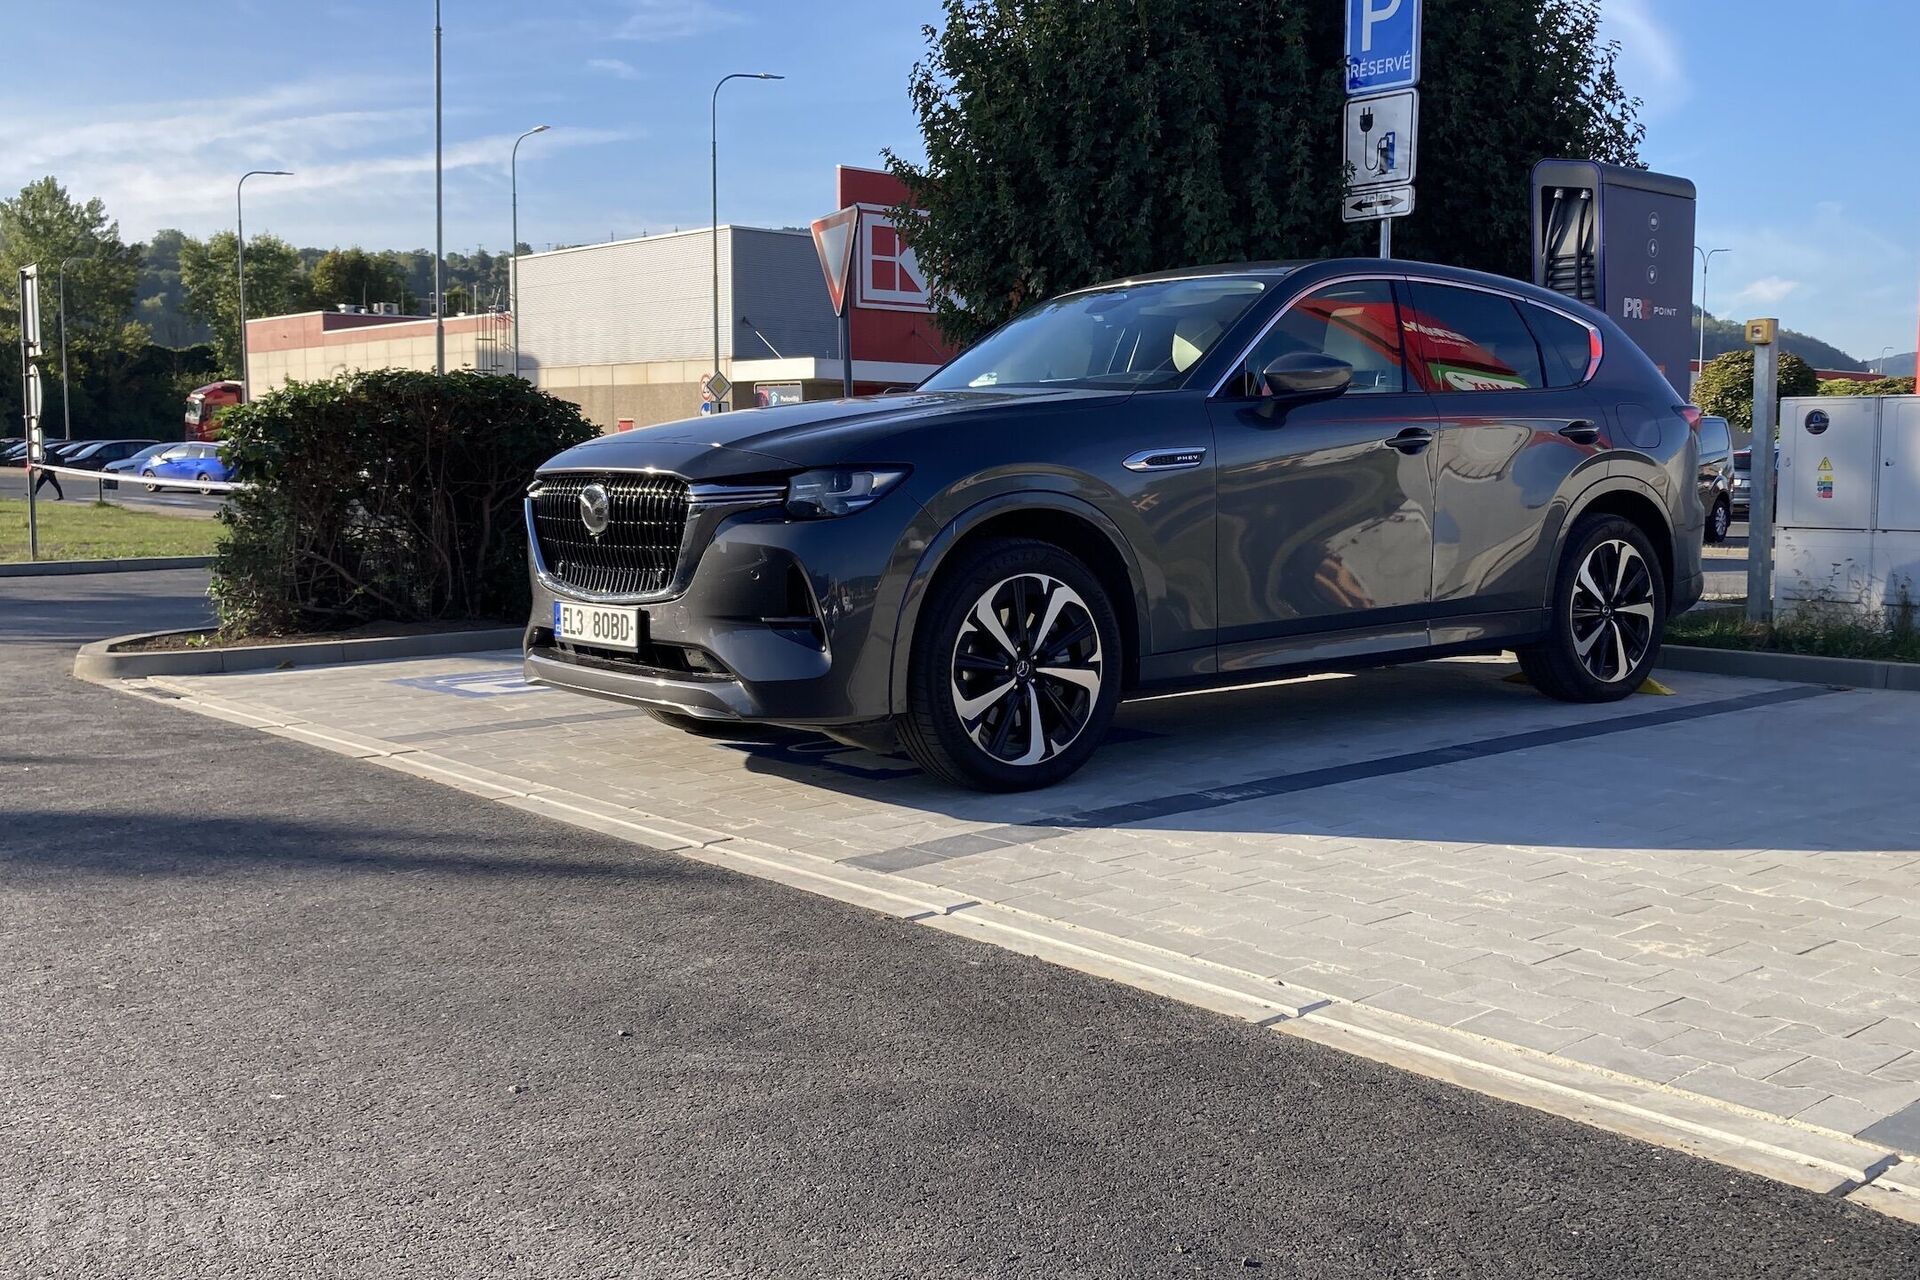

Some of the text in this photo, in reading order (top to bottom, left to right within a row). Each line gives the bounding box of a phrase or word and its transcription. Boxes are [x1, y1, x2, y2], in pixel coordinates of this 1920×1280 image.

[1362, 0, 1402, 52] P
[1350, 50, 1412, 79] RÉSERVÉ
[1653, 306, 1678, 317] POINT
[563, 607, 630, 641] EL3 80BD
